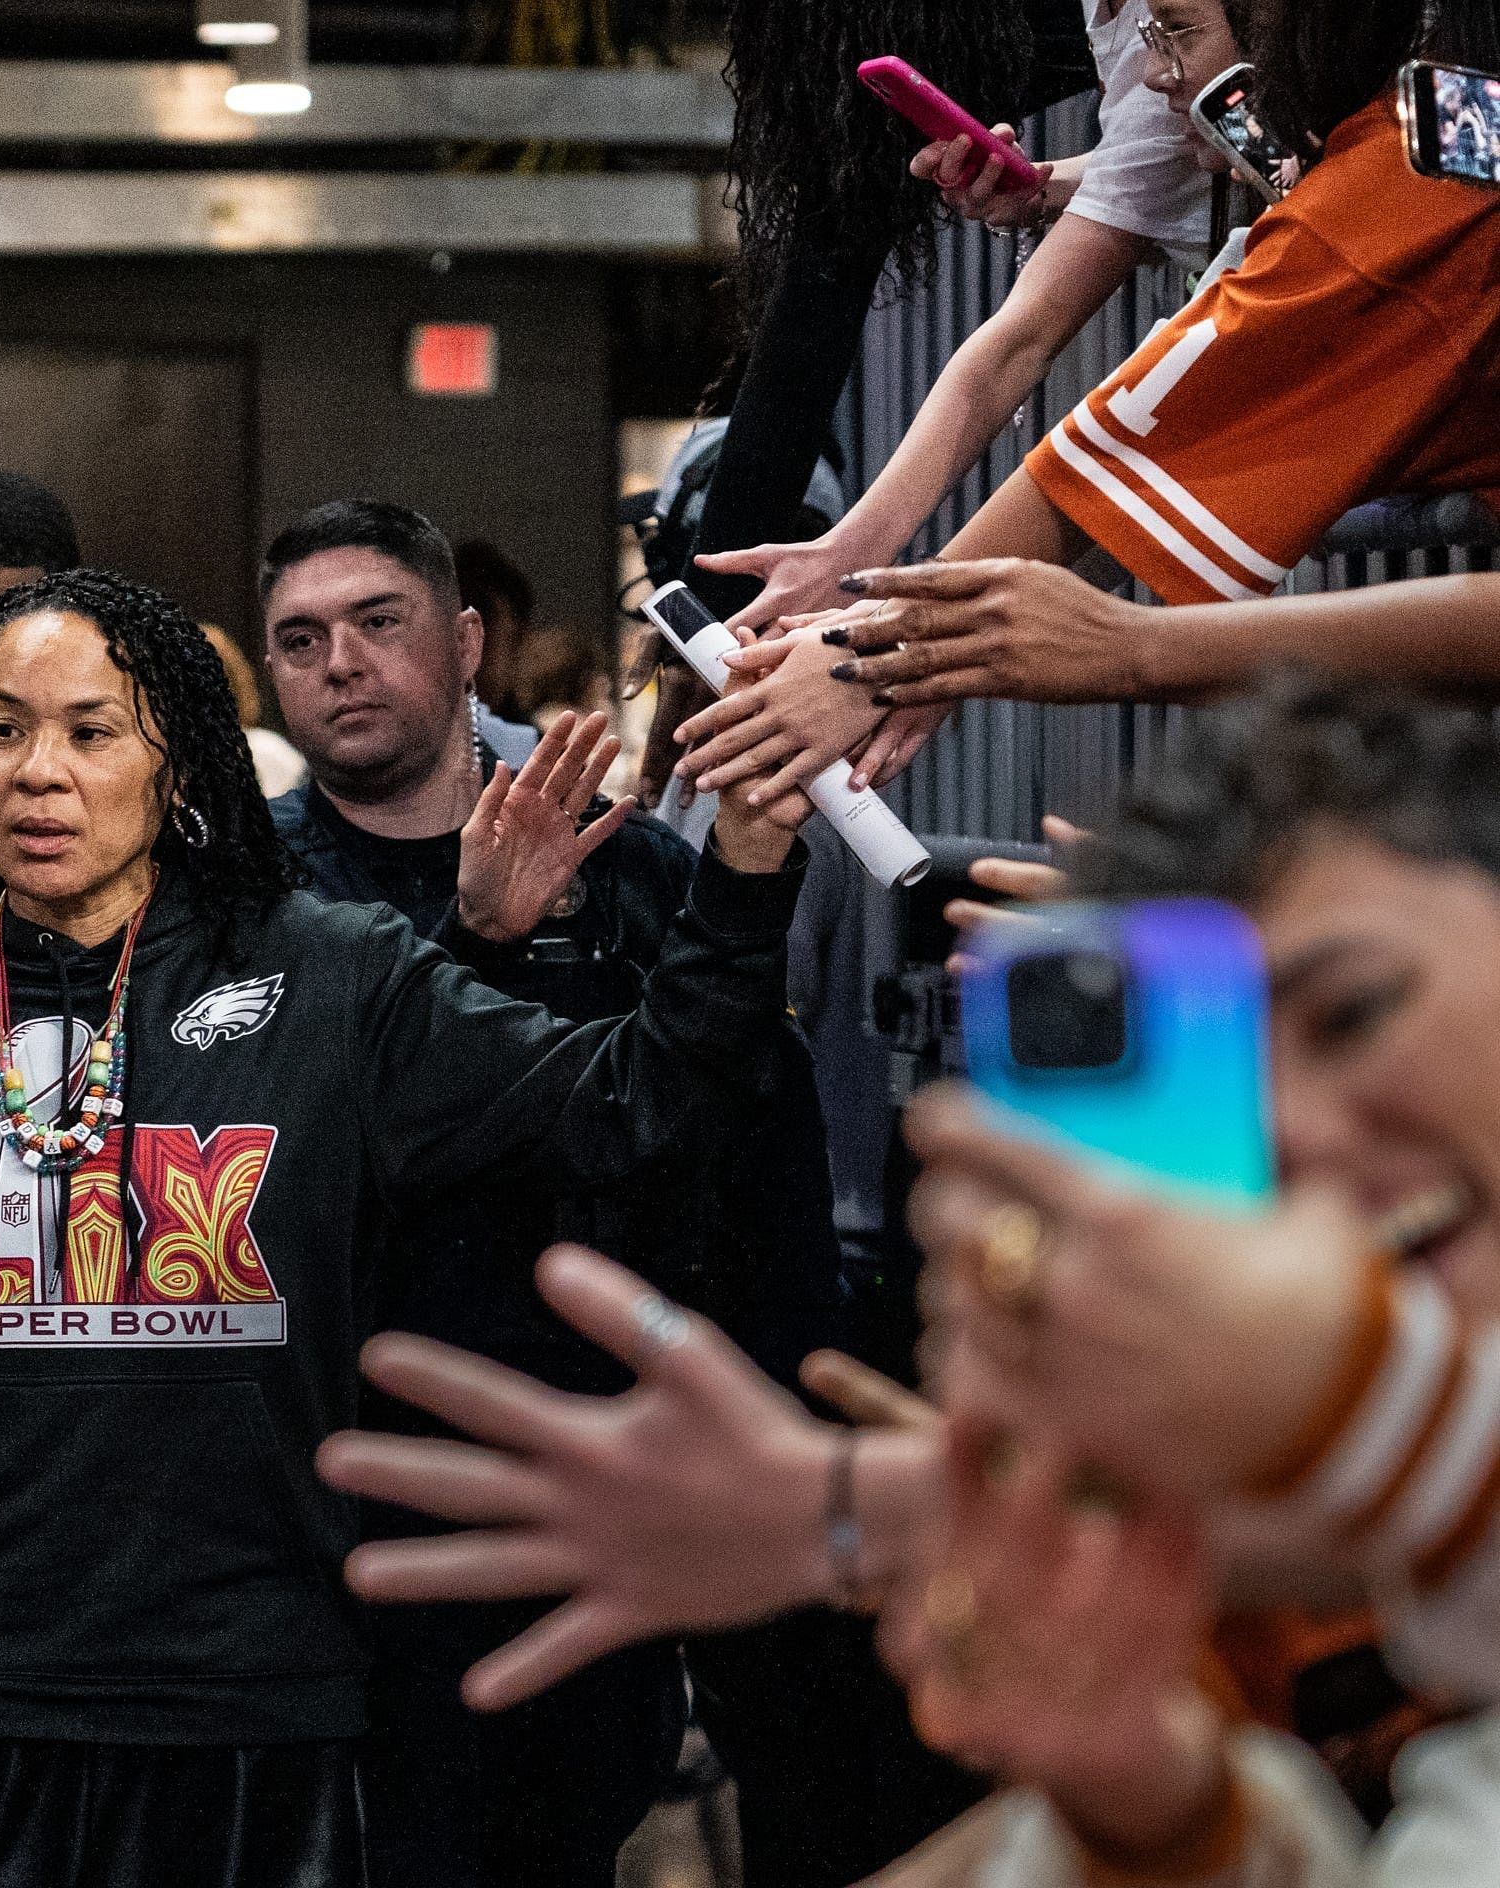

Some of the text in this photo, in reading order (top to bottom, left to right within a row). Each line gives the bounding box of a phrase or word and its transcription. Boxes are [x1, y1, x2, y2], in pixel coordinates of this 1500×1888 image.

[1106, 317, 1218, 437] 1
[4, 1206, 28, 1224] NFL
[111, 1311, 244, 1336] BOWL
